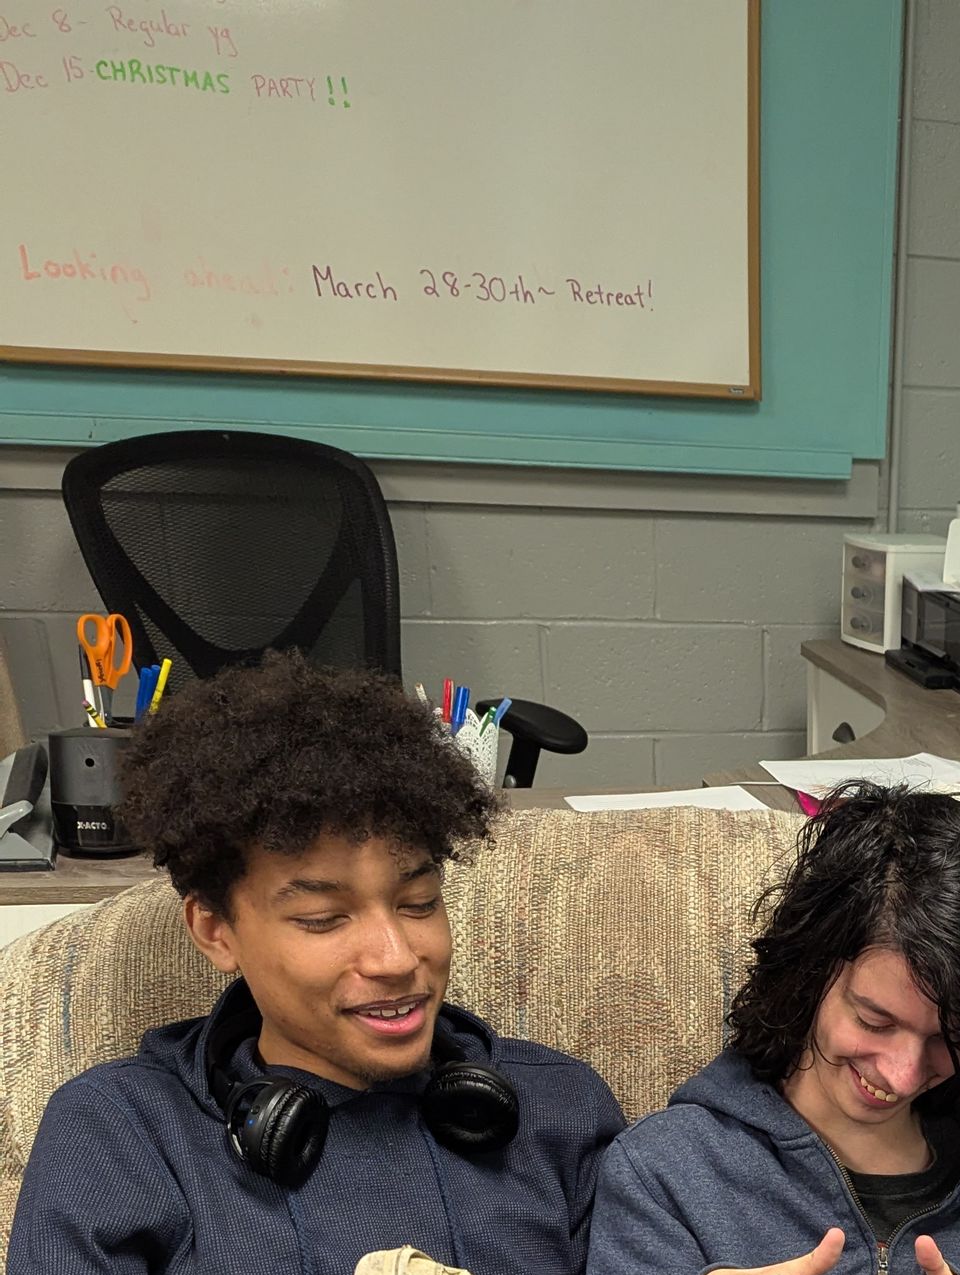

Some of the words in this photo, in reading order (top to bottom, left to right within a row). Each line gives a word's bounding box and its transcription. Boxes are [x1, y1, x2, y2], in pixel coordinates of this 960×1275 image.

[106, 7, 191, 47] Regular
[1, 61, 48, 93] Dec
[95, 59, 230, 94] CHRISTMAS
[18, 244, 150, 300] Looking
[312, 265, 397, 301] March
[566, 278, 653, 311] Retreat!
